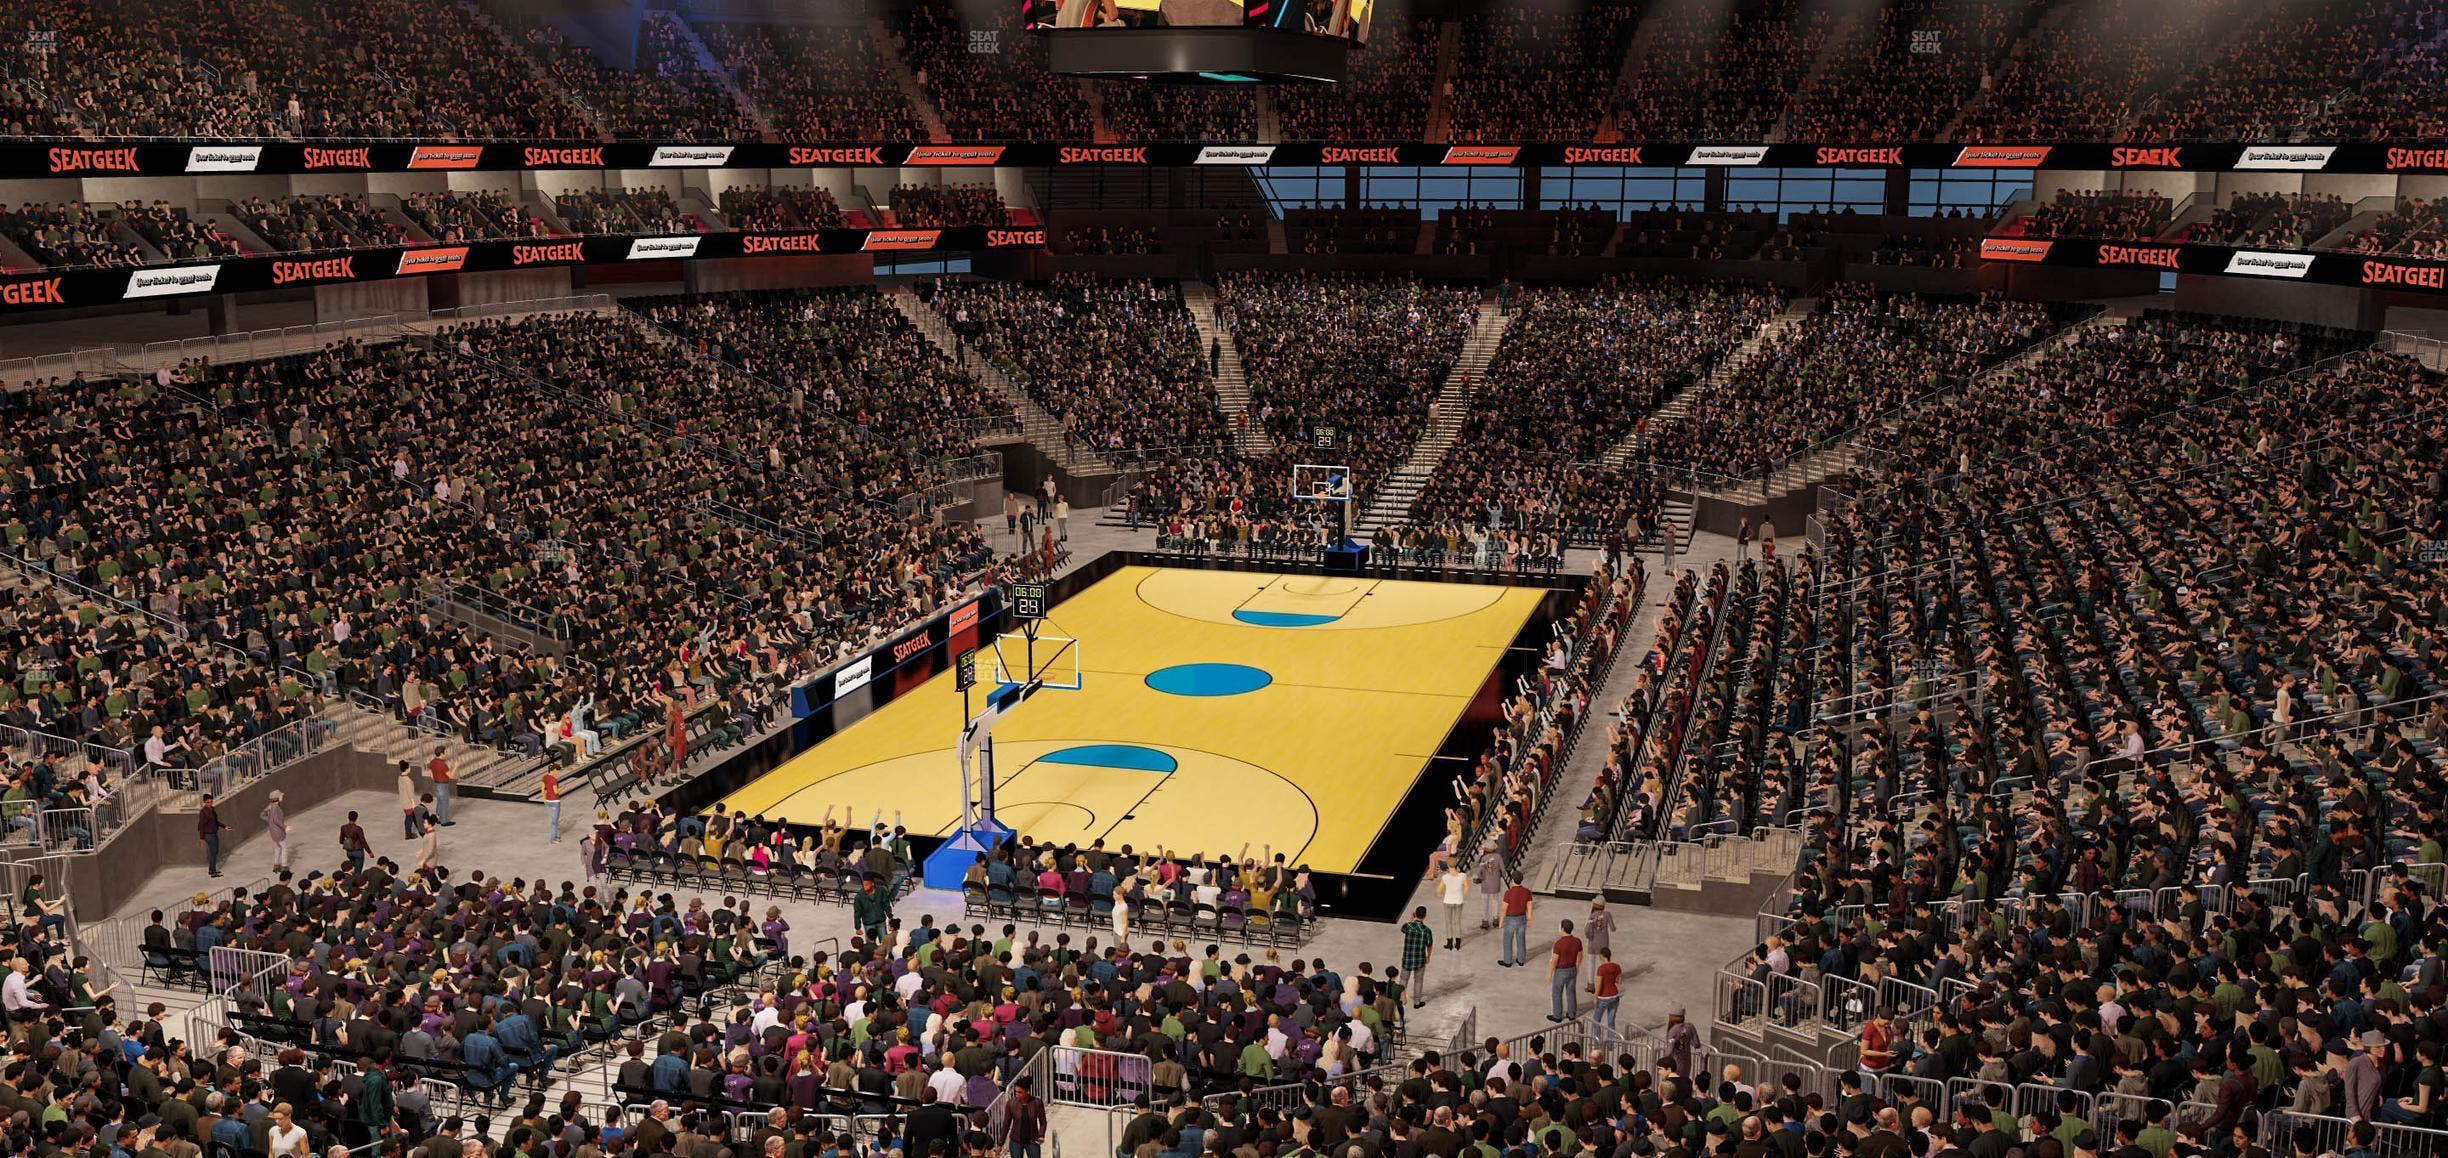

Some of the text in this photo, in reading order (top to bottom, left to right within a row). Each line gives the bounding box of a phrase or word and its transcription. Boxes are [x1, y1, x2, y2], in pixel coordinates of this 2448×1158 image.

[49, 147, 140, 172] SEATGEEK
[303, 147, 371, 169] SEATGEEK
[524, 146, 605, 166] SEATGEEK
[790, 146, 883, 164] SEATGEEK
[1060, 147, 1147, 163] SEATGEEK
[1321, 147, 1399, 163] SEATGEEK
[1563, 147, 1642, 164] SEATGEEK
[1816, 147, 1903, 165] SEATGEEK
[513, 242, 584, 265] SEATGEEK
[743, 234, 820, 253] SEATGEEK
[2098, 245, 2180, 268] SEATGEEK
[272, 256, 355, 284] SEATGEEK
[0, 277, 64, 304] GEEK
[1015, 586, 1042, 598] 06:00
[893, 629, 932, 663] SEATGEEK
